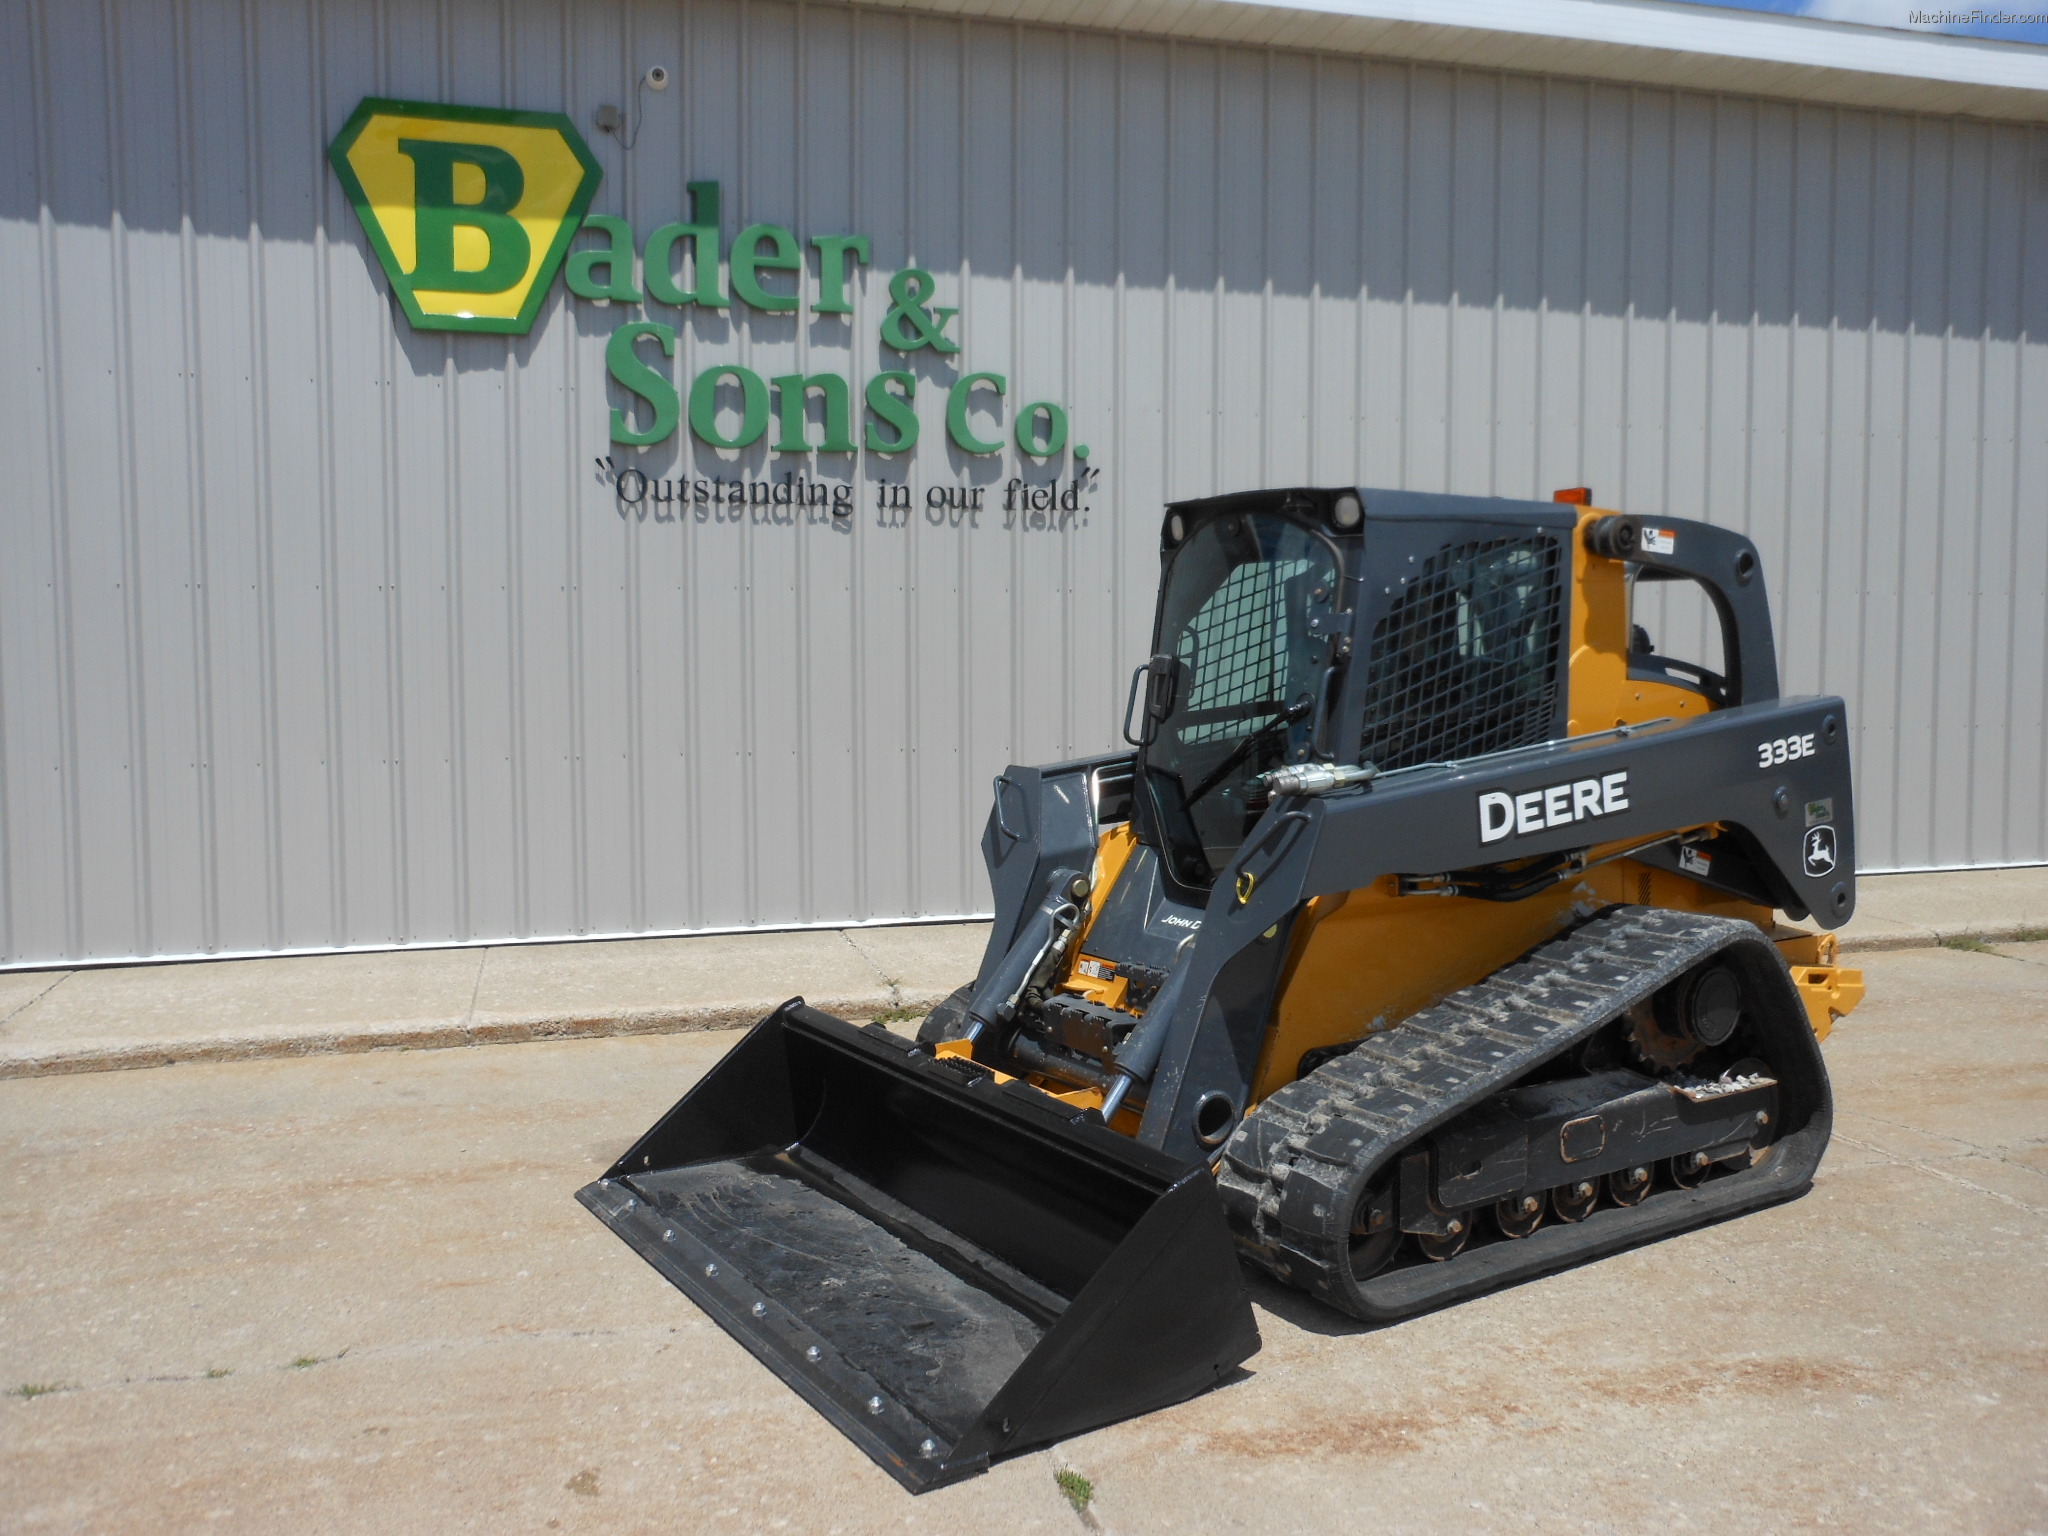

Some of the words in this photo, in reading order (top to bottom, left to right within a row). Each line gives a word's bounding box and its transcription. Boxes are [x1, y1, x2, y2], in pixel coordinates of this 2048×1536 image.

[881, 267, 961, 354] &
[604, 321, 920, 453] Sons
[945, 371, 1090, 459] Co.
[878, 478, 912, 509] in
[926, 485, 985, 510] our
[1757, 733, 1816, 768] 333E
[1478, 771, 1630, 844] DEERE
[1161, 914, 1193, 928] JOHN
